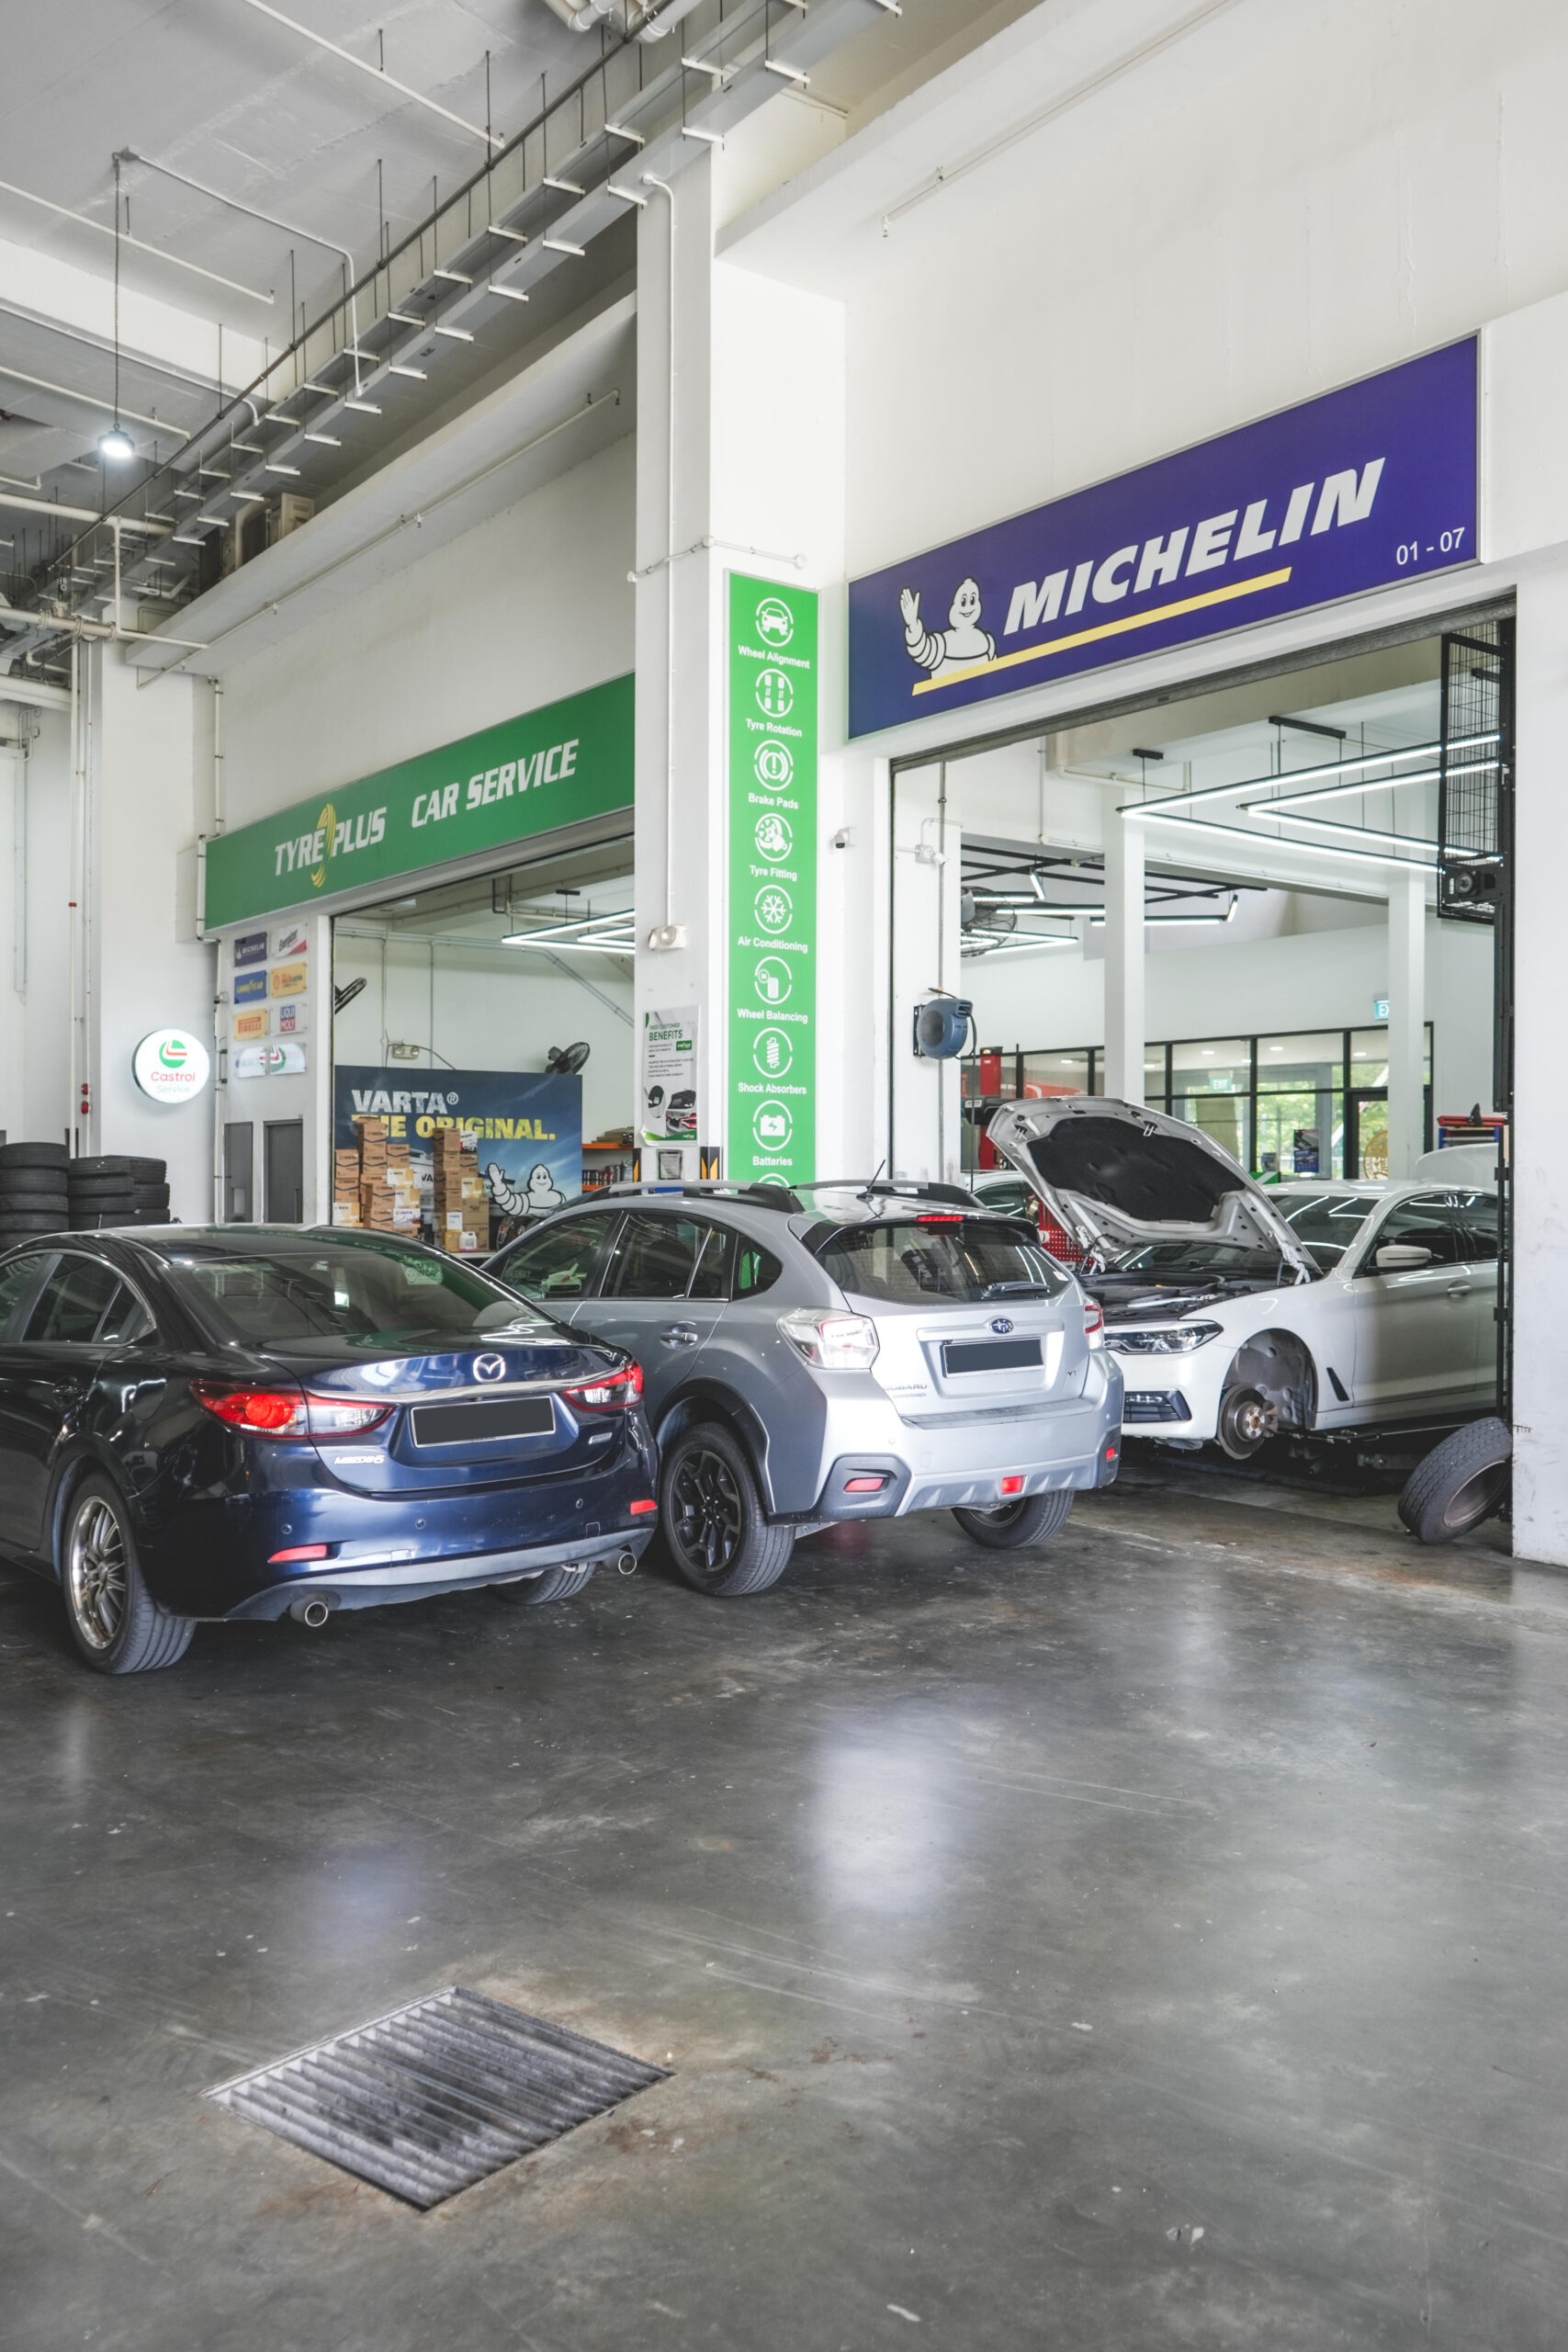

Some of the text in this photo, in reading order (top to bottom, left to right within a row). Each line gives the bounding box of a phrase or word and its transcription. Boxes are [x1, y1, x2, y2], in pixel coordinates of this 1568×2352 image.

[1003, 457, 1385, 636] MICHELIN
[1395, 542, 1418, 565] 01
[1438, 527, 1466, 554] 07
[738, 644, 810, 669] Wheel Alignment
[746, 718, 803, 738] Tyre Rotation
[412, 782, 459, 829] CAR
[466, 738, 580, 810] SERVICE
[748, 792, 799, 809] Brake Pads
[750, 865, 798, 882] Tyre Fitting
[738, 935, 808, 955] Air Conditioning
[737, 1008, 808, 1024] Wheel Balancing
[280, 1019, 295, 1031] MOLY
[649, 1029, 682, 1042] BENEFITS
[151, 1071, 196, 1082] Castrol
[157, 1084, 190, 1093] Service
[738, 1081, 807, 1094] Shock Absorbers
[752, 1155, 793, 1167] Batteries
